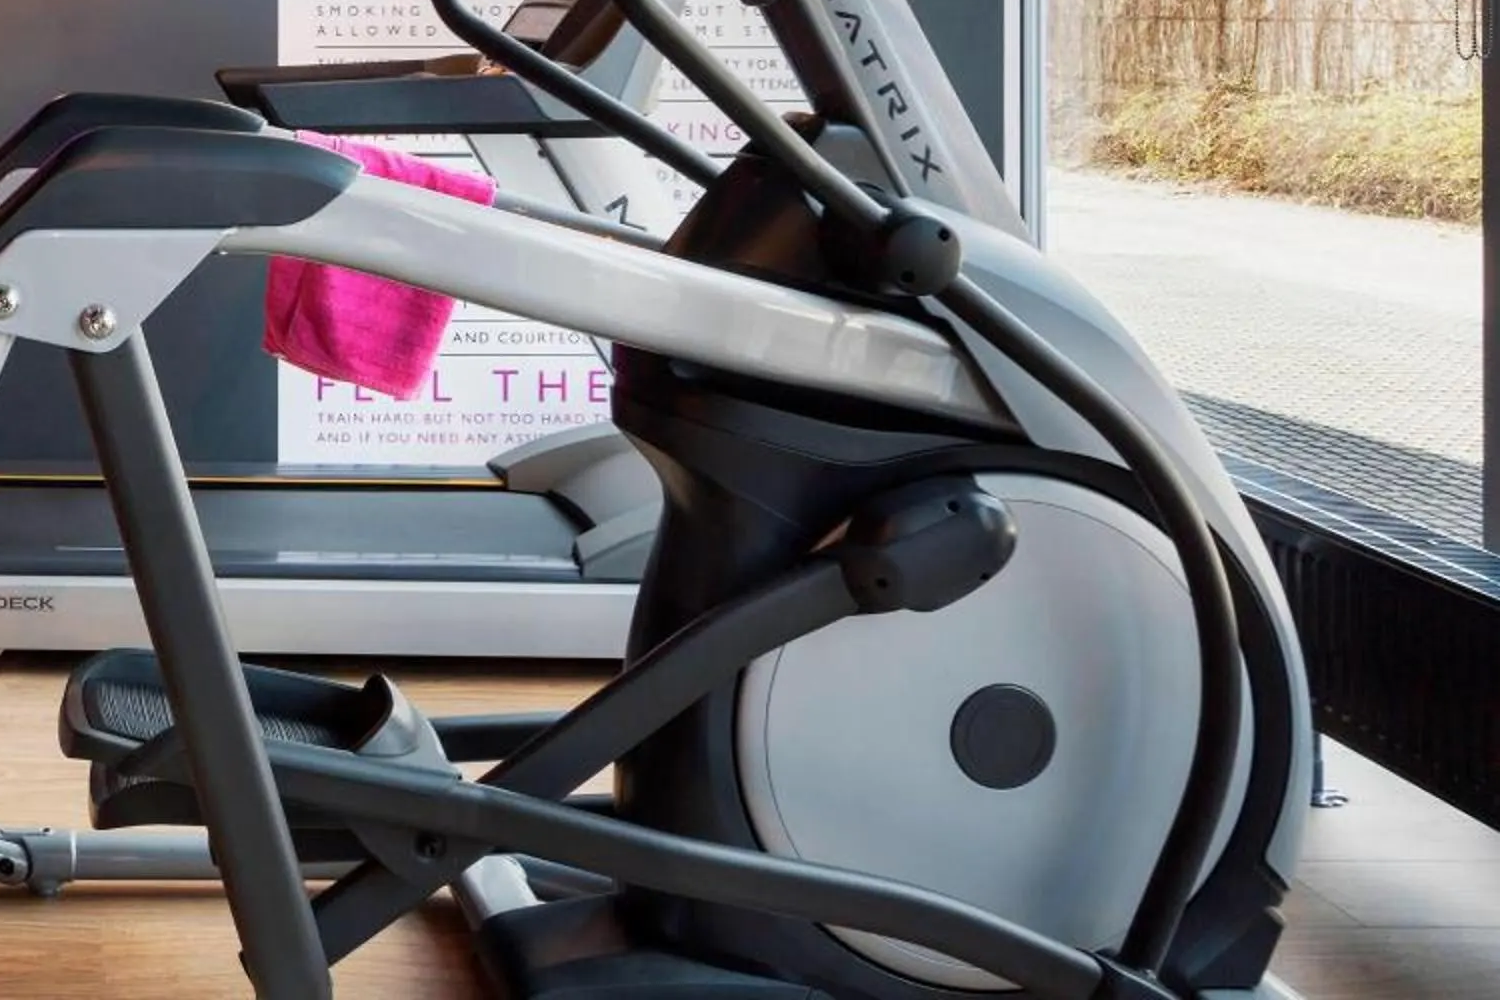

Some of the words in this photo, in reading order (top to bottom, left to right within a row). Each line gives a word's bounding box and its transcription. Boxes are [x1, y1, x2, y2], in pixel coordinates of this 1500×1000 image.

[316, 5, 422, 18] SMOKING
[316, 24, 438, 38] ALLOWED
[452, 331, 490, 344] AND
[492, 369, 609, 403] THE
[316, 412, 365, 425] TRAIN
[422, 412, 453, 425] BUT
[461, 412, 495, 425] NOT
[499, 412, 535, 425] TOO
[316, 432, 351, 444] AND
[358, 432, 371, 444] IF
[377, 432, 411, 444] YOU
[416, 432, 459, 444] NEED
[464, 432, 499, 445] ANY
